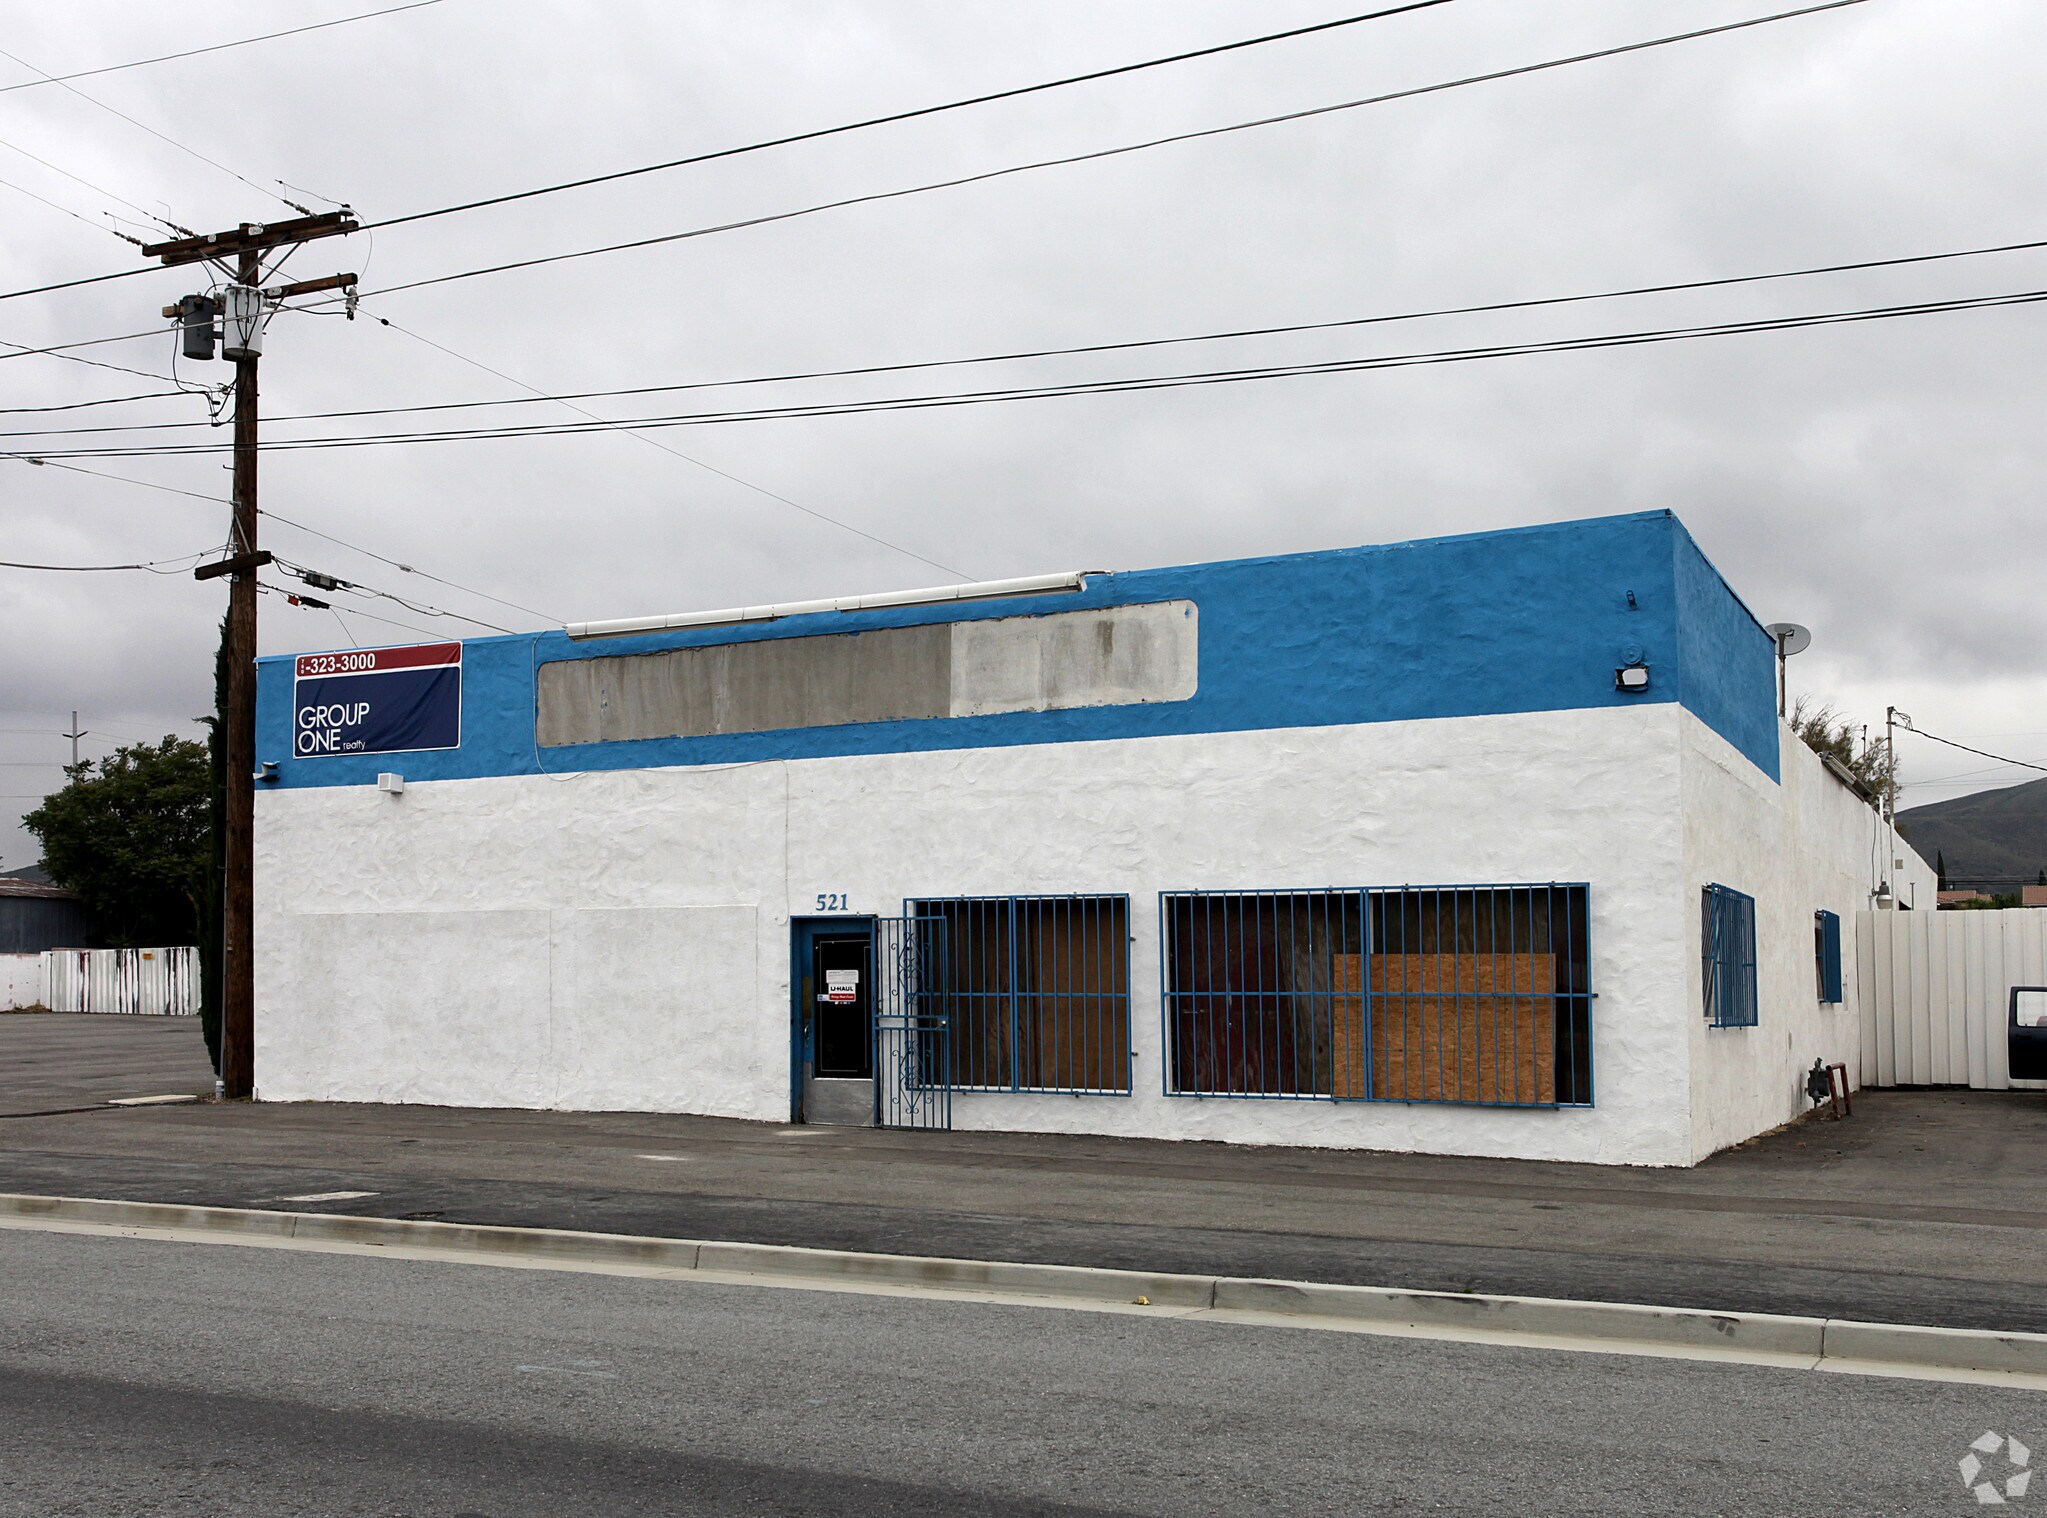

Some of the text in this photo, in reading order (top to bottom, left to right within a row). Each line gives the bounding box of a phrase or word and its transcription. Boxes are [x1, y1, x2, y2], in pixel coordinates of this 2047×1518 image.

[299, 702, 370, 729] GROUP
[298, 729, 366, 753] ONE realty
[816, 893, 848, 911] 521
